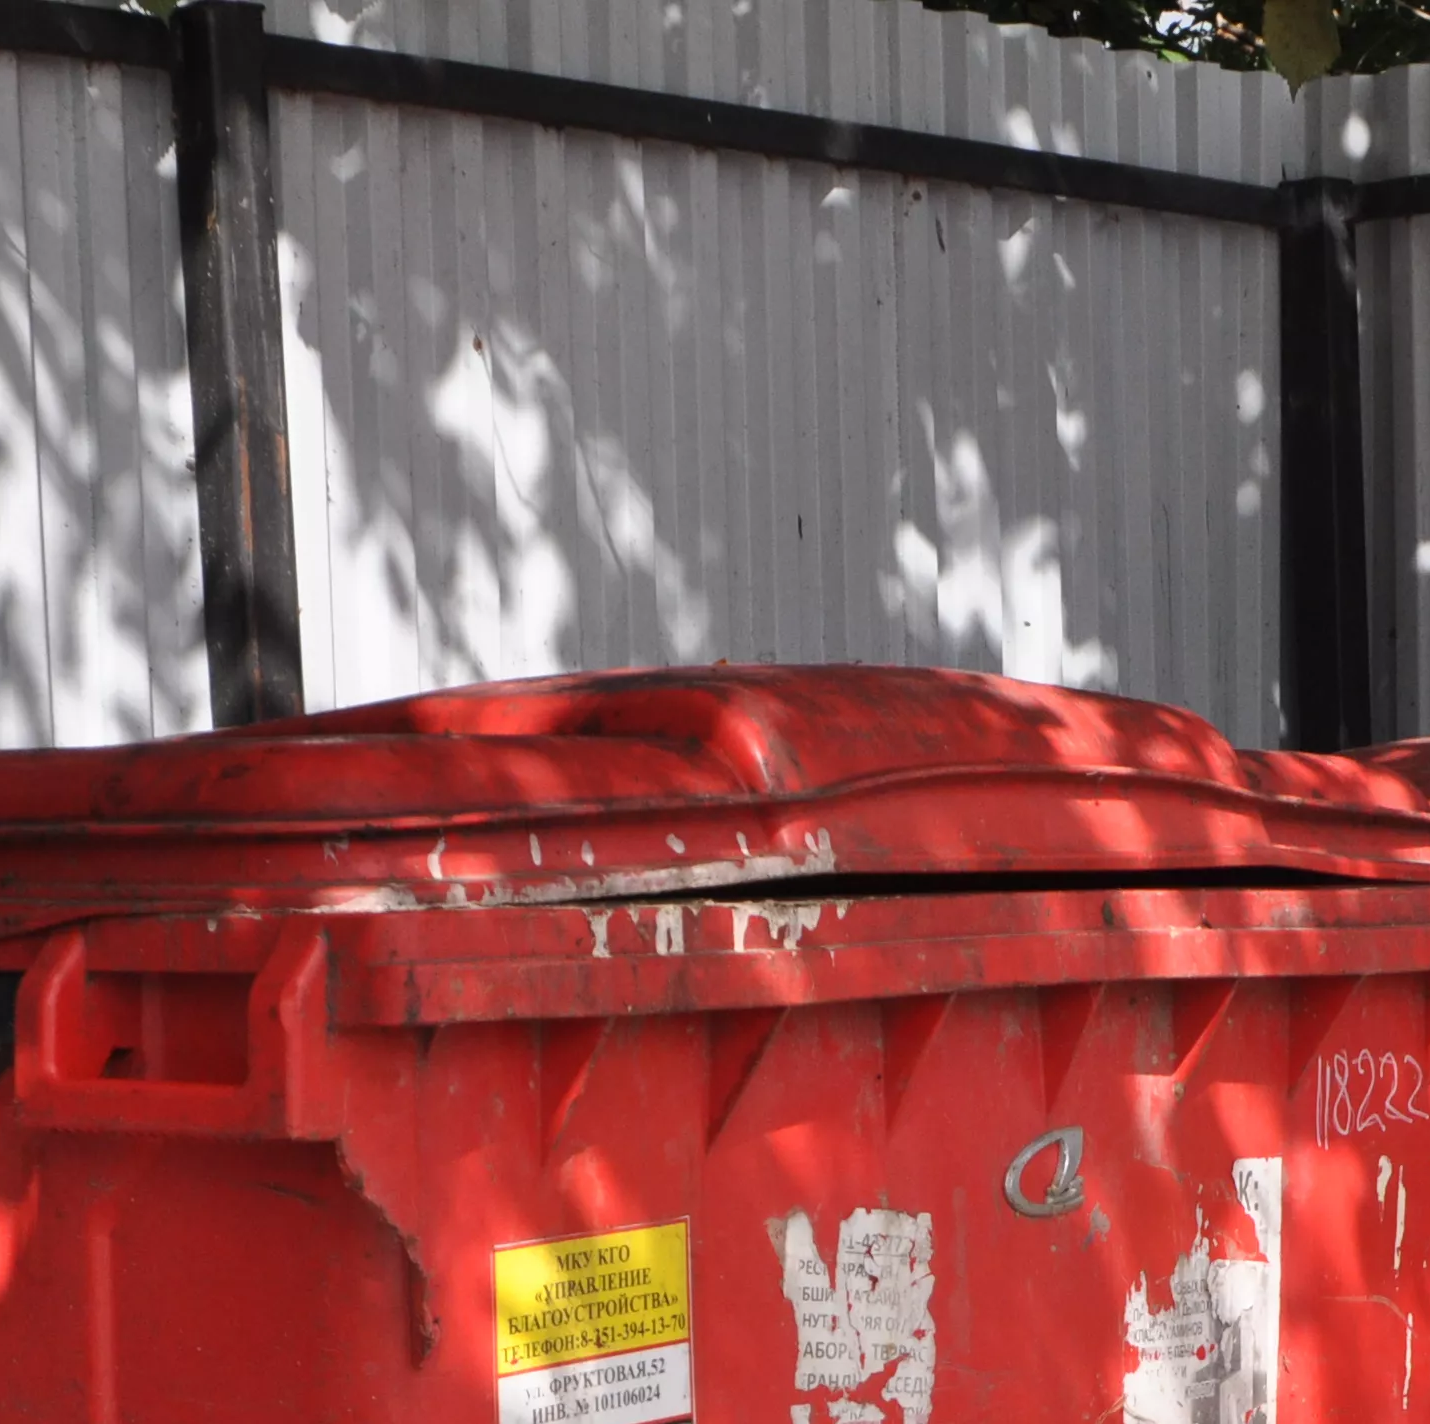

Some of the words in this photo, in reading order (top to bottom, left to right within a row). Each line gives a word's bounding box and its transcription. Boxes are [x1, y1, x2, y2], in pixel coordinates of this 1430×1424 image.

[556, 1250, 594, 1272] МКУ
[599, 1244, 630, 1266] КГО
[535, 1267, 652, 1304] «УПРАВЛЕНИЕ
[508, 1291, 679, 1335] БЛАГОУСТРОЙСТВА»
[594, 1384, 661, 1413] 101106024
